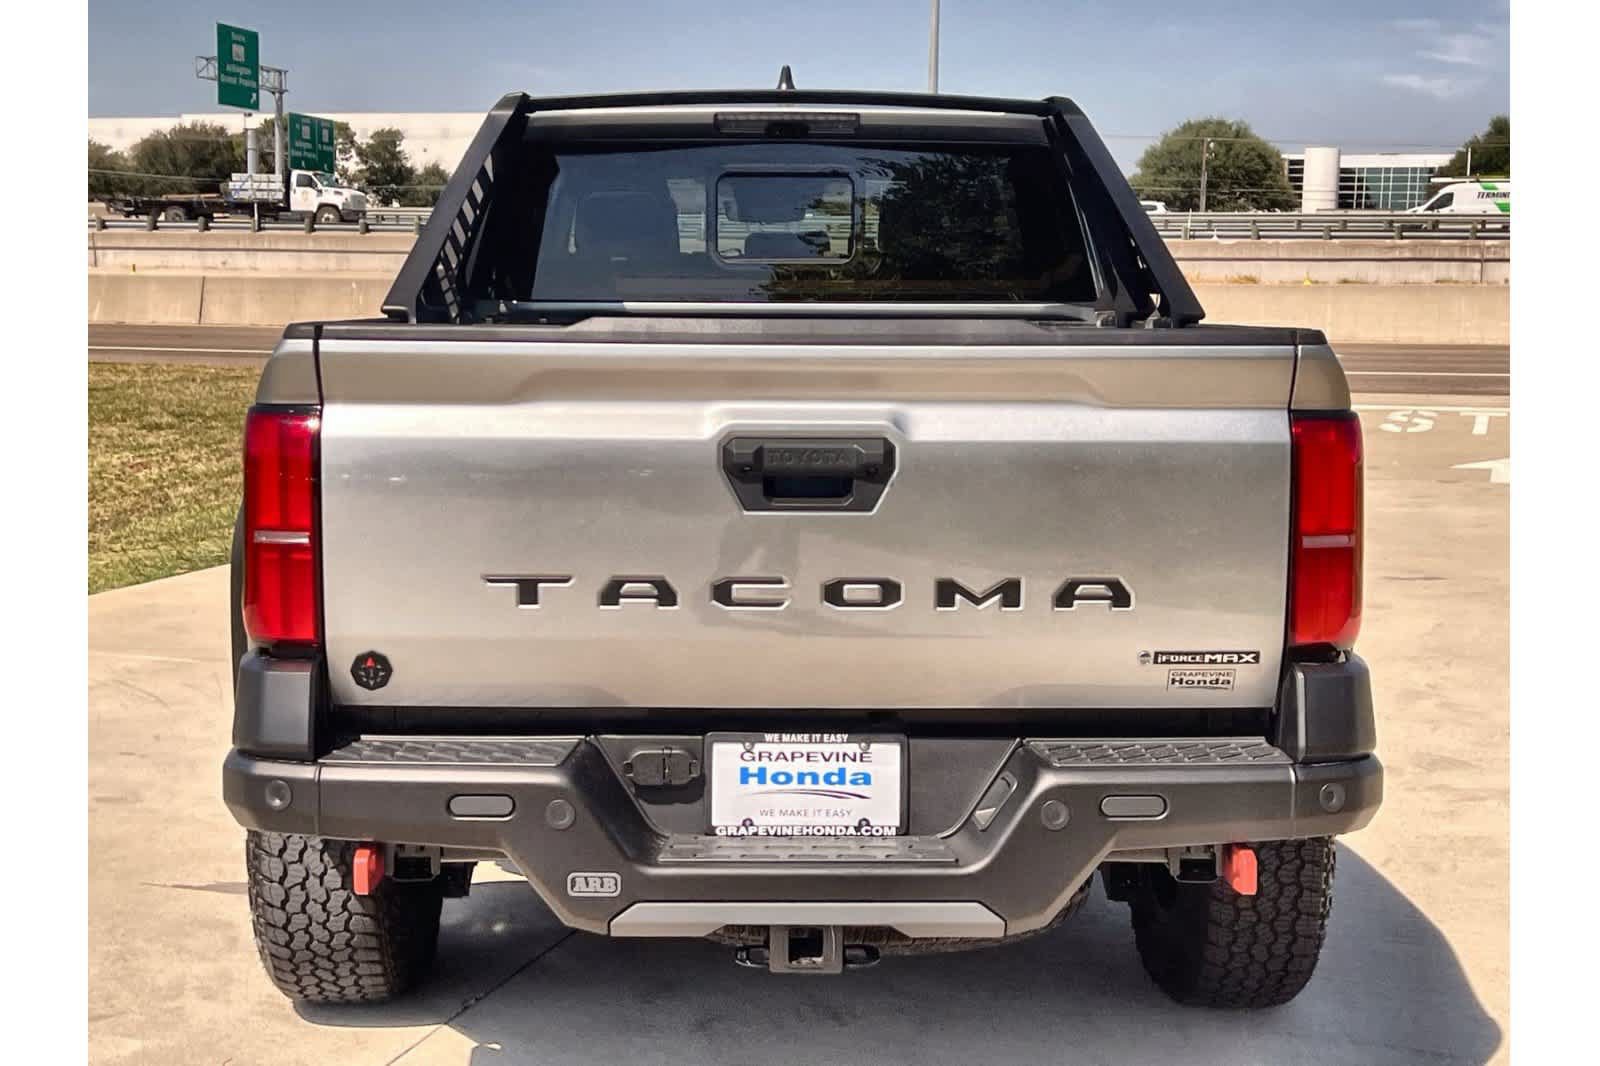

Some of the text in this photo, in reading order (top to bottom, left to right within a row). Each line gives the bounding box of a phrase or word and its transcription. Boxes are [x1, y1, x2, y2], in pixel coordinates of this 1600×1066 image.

[767, 450, 845, 465] TOYOTA
[482, 575, 1136, 610] TACOMA
[764, 734, 848, 743] WE MAKE IT EASY
[740, 751, 873, 763] GRAPEVINE
[739, 767, 872, 786] Honda
[759, 809, 853, 818] WE MAKE IT EASY
[715, 825, 897, 836] GRAPEVINEHONDA.COM
[573, 877, 617, 892] ARB
